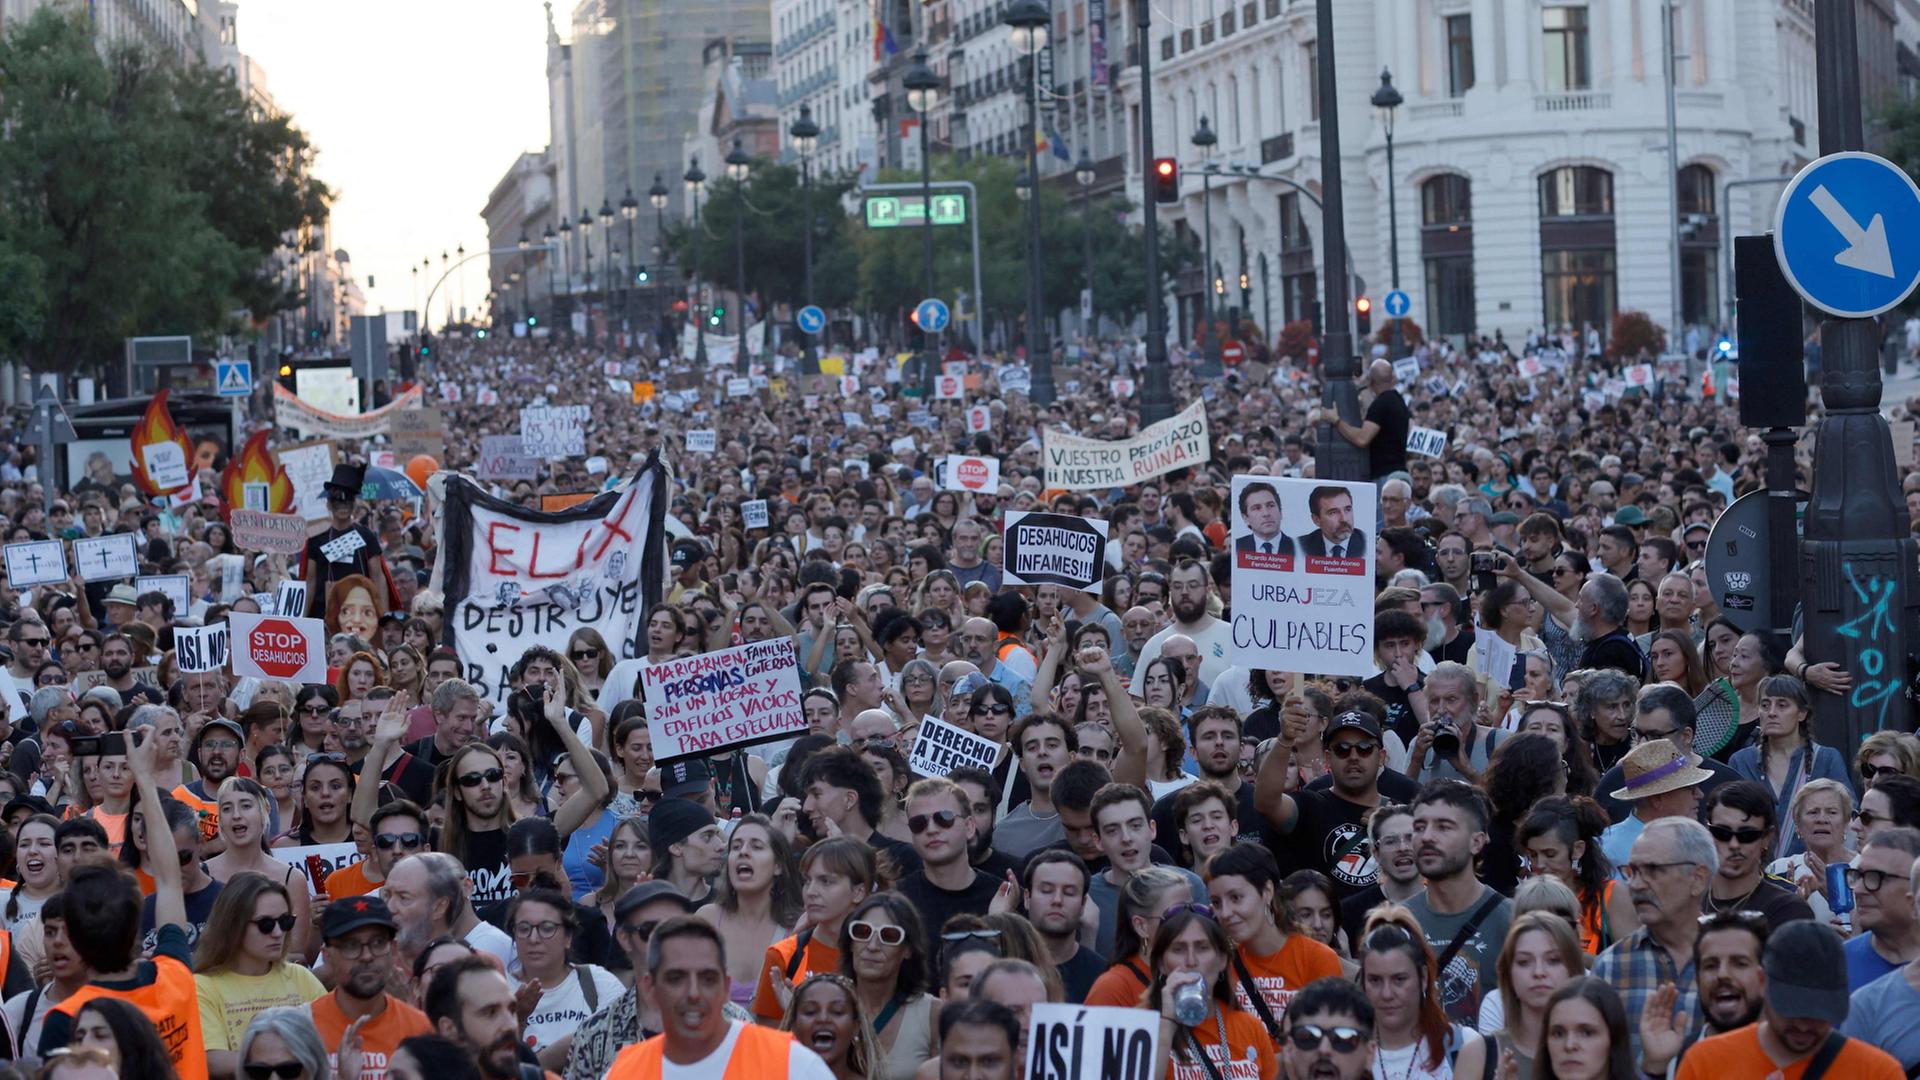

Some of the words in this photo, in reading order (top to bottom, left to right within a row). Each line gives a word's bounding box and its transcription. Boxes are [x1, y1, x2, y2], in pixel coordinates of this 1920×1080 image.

[1050, 448, 1121, 466] VUESTRO
[1129, 420, 1203, 461] PELOTAZO
[1427, 435, 1444, 455] NO
[959, 464, 986, 474] STOP
[1020, 528, 1096, 553] DESAHUCIOS
[1018, 554, 1093, 579] INFAMES!!!
[1245, 553, 1268, 561] Ricardo
[1251, 560, 1281, 569] Fernández
[1311, 558, 1339, 566] Fernando
[283, 587, 305, 617] NO
[464, 579, 638, 637] DESTRUYE
[208, 630, 225, 666] NO
[254, 631, 301, 648] STOP
[1233, 614, 1366, 655] CULPABLES
[253, 649, 305, 665] DESAHUCIOS
[653, 703, 680, 720] SIN
[686, 695, 706, 711] UN
[713, 682, 760, 709] HOGAR
[766, 678, 778, 693] Y
[663, 667, 745, 703] PERSONAS
[664, 706, 734, 737] EDIFICIOS
[678, 730, 723, 753] PARA
[725, 710, 807, 741] ESPECULAR
[914, 739, 928, 758] A
[921, 720, 997, 764] DERECHO
[1101, 1027, 1152, 1080] NO
